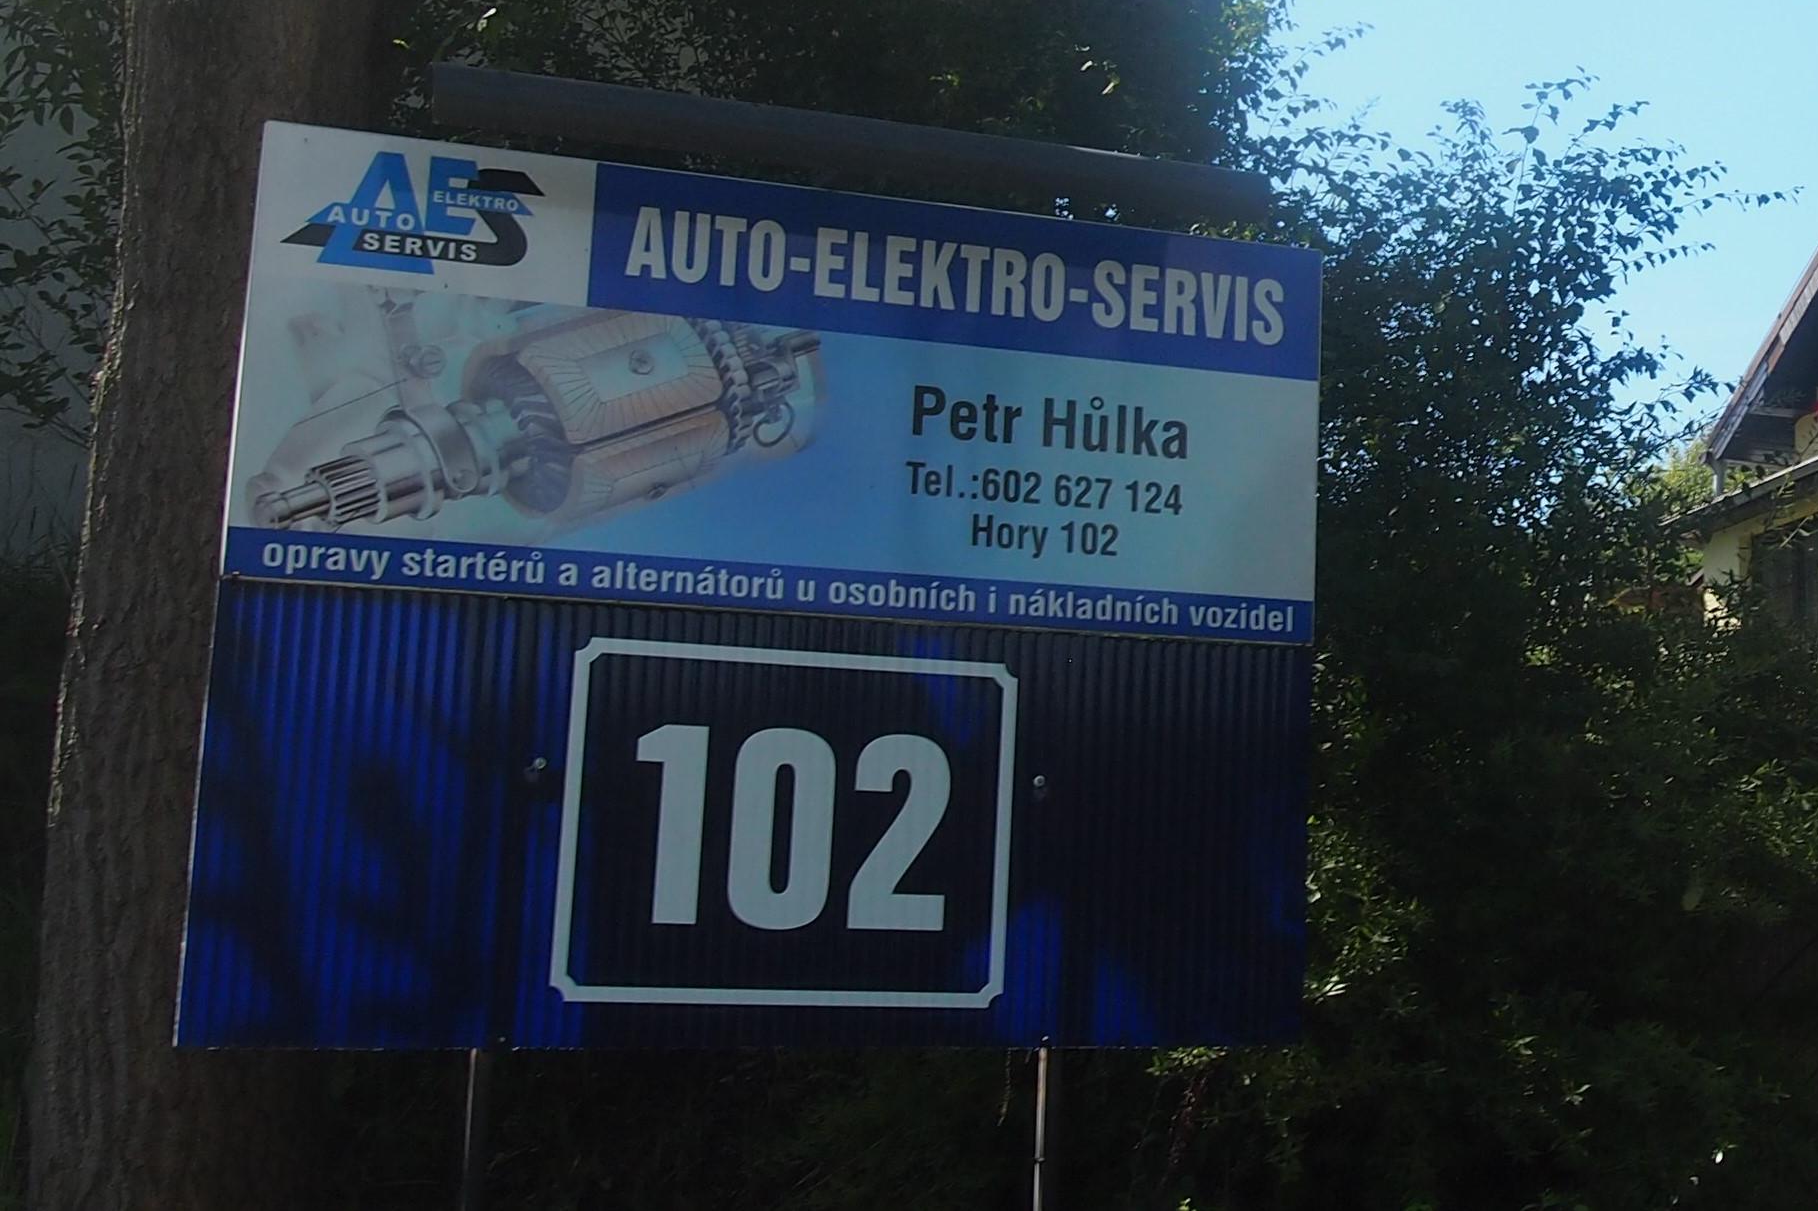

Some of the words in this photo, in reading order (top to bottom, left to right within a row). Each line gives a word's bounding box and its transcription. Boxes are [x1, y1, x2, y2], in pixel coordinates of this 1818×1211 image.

[326, 204, 416, 231] AUTO
[432, 189, 520, 213] ELEKTRO
[362, 232, 478, 263] SERVIS
[625, 205, 1285, 346] AUTO-ELEKTRO-SERVIS
[911, 384, 1023, 444] Petr
[1042, 396, 1188, 460] Hůlka
[1054, 473, 1113, 510] 627
[1125, 479, 1183, 516] 124
[971, 513, 1049, 559] Hory
[1060, 520, 1119, 557] 102
[262, 540, 391, 581] opravy
[401, 550, 545, 585] startérů
[557, 561, 578, 587] a
[591, 559, 785, 601] alternátorů
[796, 581, 815, 603] u
[828, 573, 976, 613] osobních
[987, 587, 997, 614] i
[1008, 589, 1179, 625] nákladních
[1189, 603, 1294, 632] vozidel
[635, 723, 951, 931] 102
